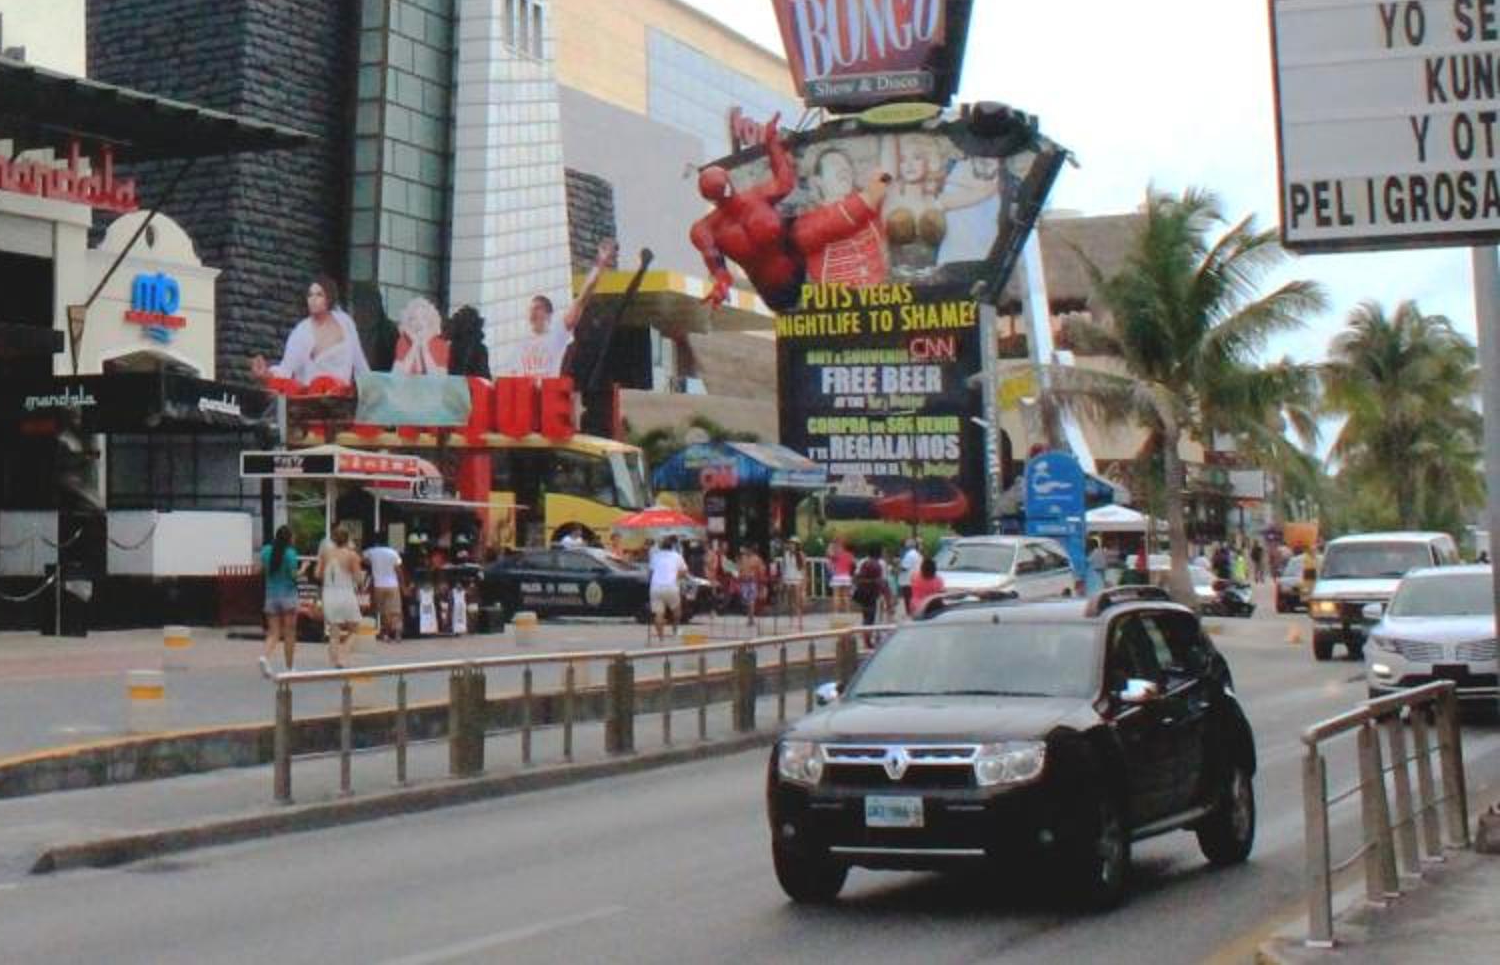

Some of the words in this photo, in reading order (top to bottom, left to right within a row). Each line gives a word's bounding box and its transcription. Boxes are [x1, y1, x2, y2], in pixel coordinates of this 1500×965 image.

[1378, 0, 1425, 49] YO
[1425, 52, 1500, 105] KUN
[1410, 114, 1430, 163] Y
[801, 283, 851, 309] PUTS
[857, 282, 914, 306] VEGAS
[869, 310, 894, 333] TO
[910, 338, 955, 358] CNN
[821, 365, 877, 394] FREE
[881, 365, 942, 394] BEER
